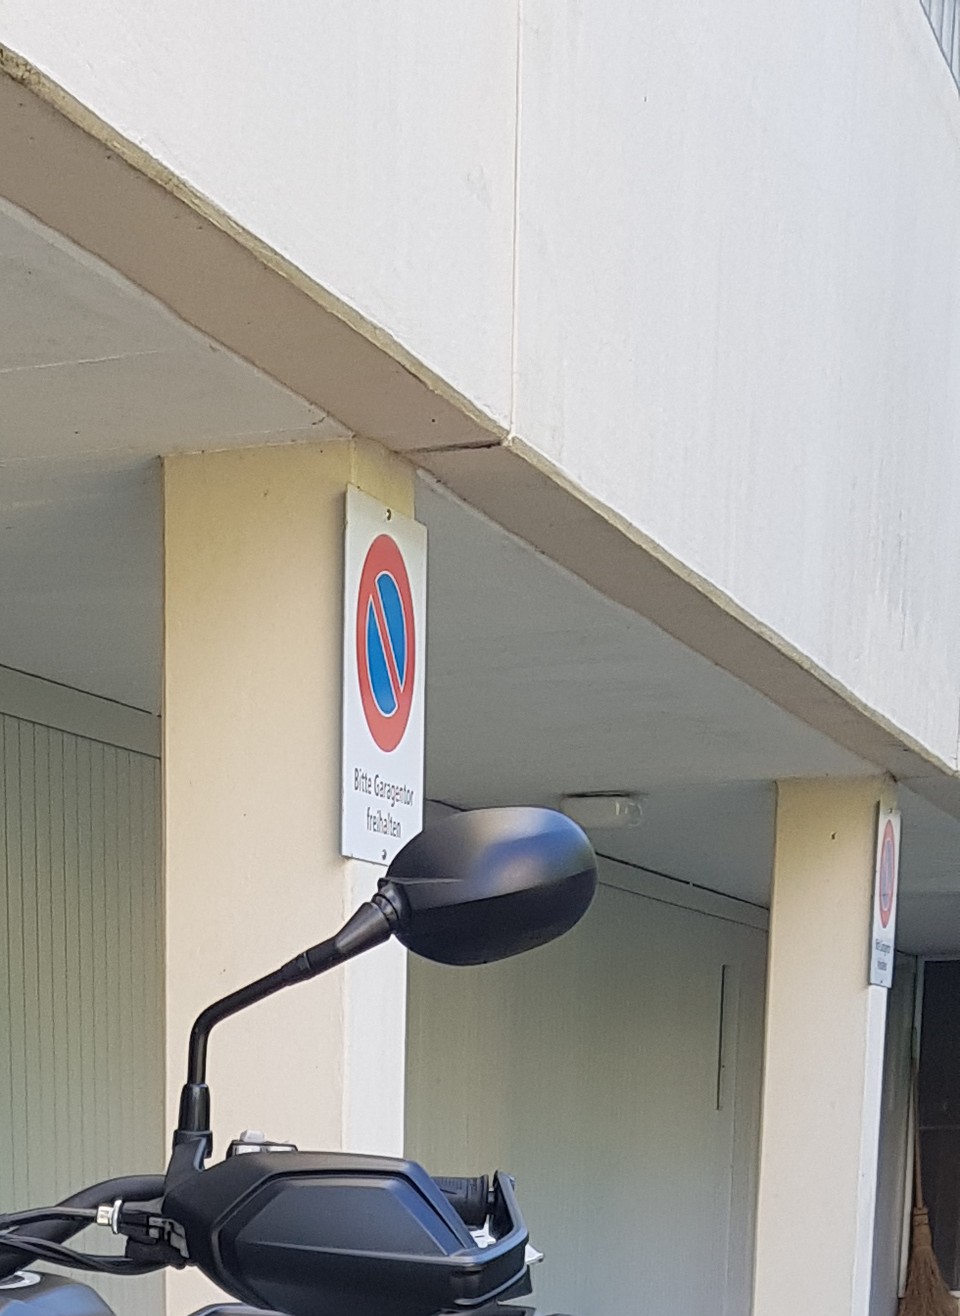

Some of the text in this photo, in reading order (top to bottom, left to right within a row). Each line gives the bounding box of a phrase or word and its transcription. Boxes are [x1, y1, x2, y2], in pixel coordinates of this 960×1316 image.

[354, 767, 414, 808] Bitte Garagentor
[366, 806, 401, 838] freihalten
